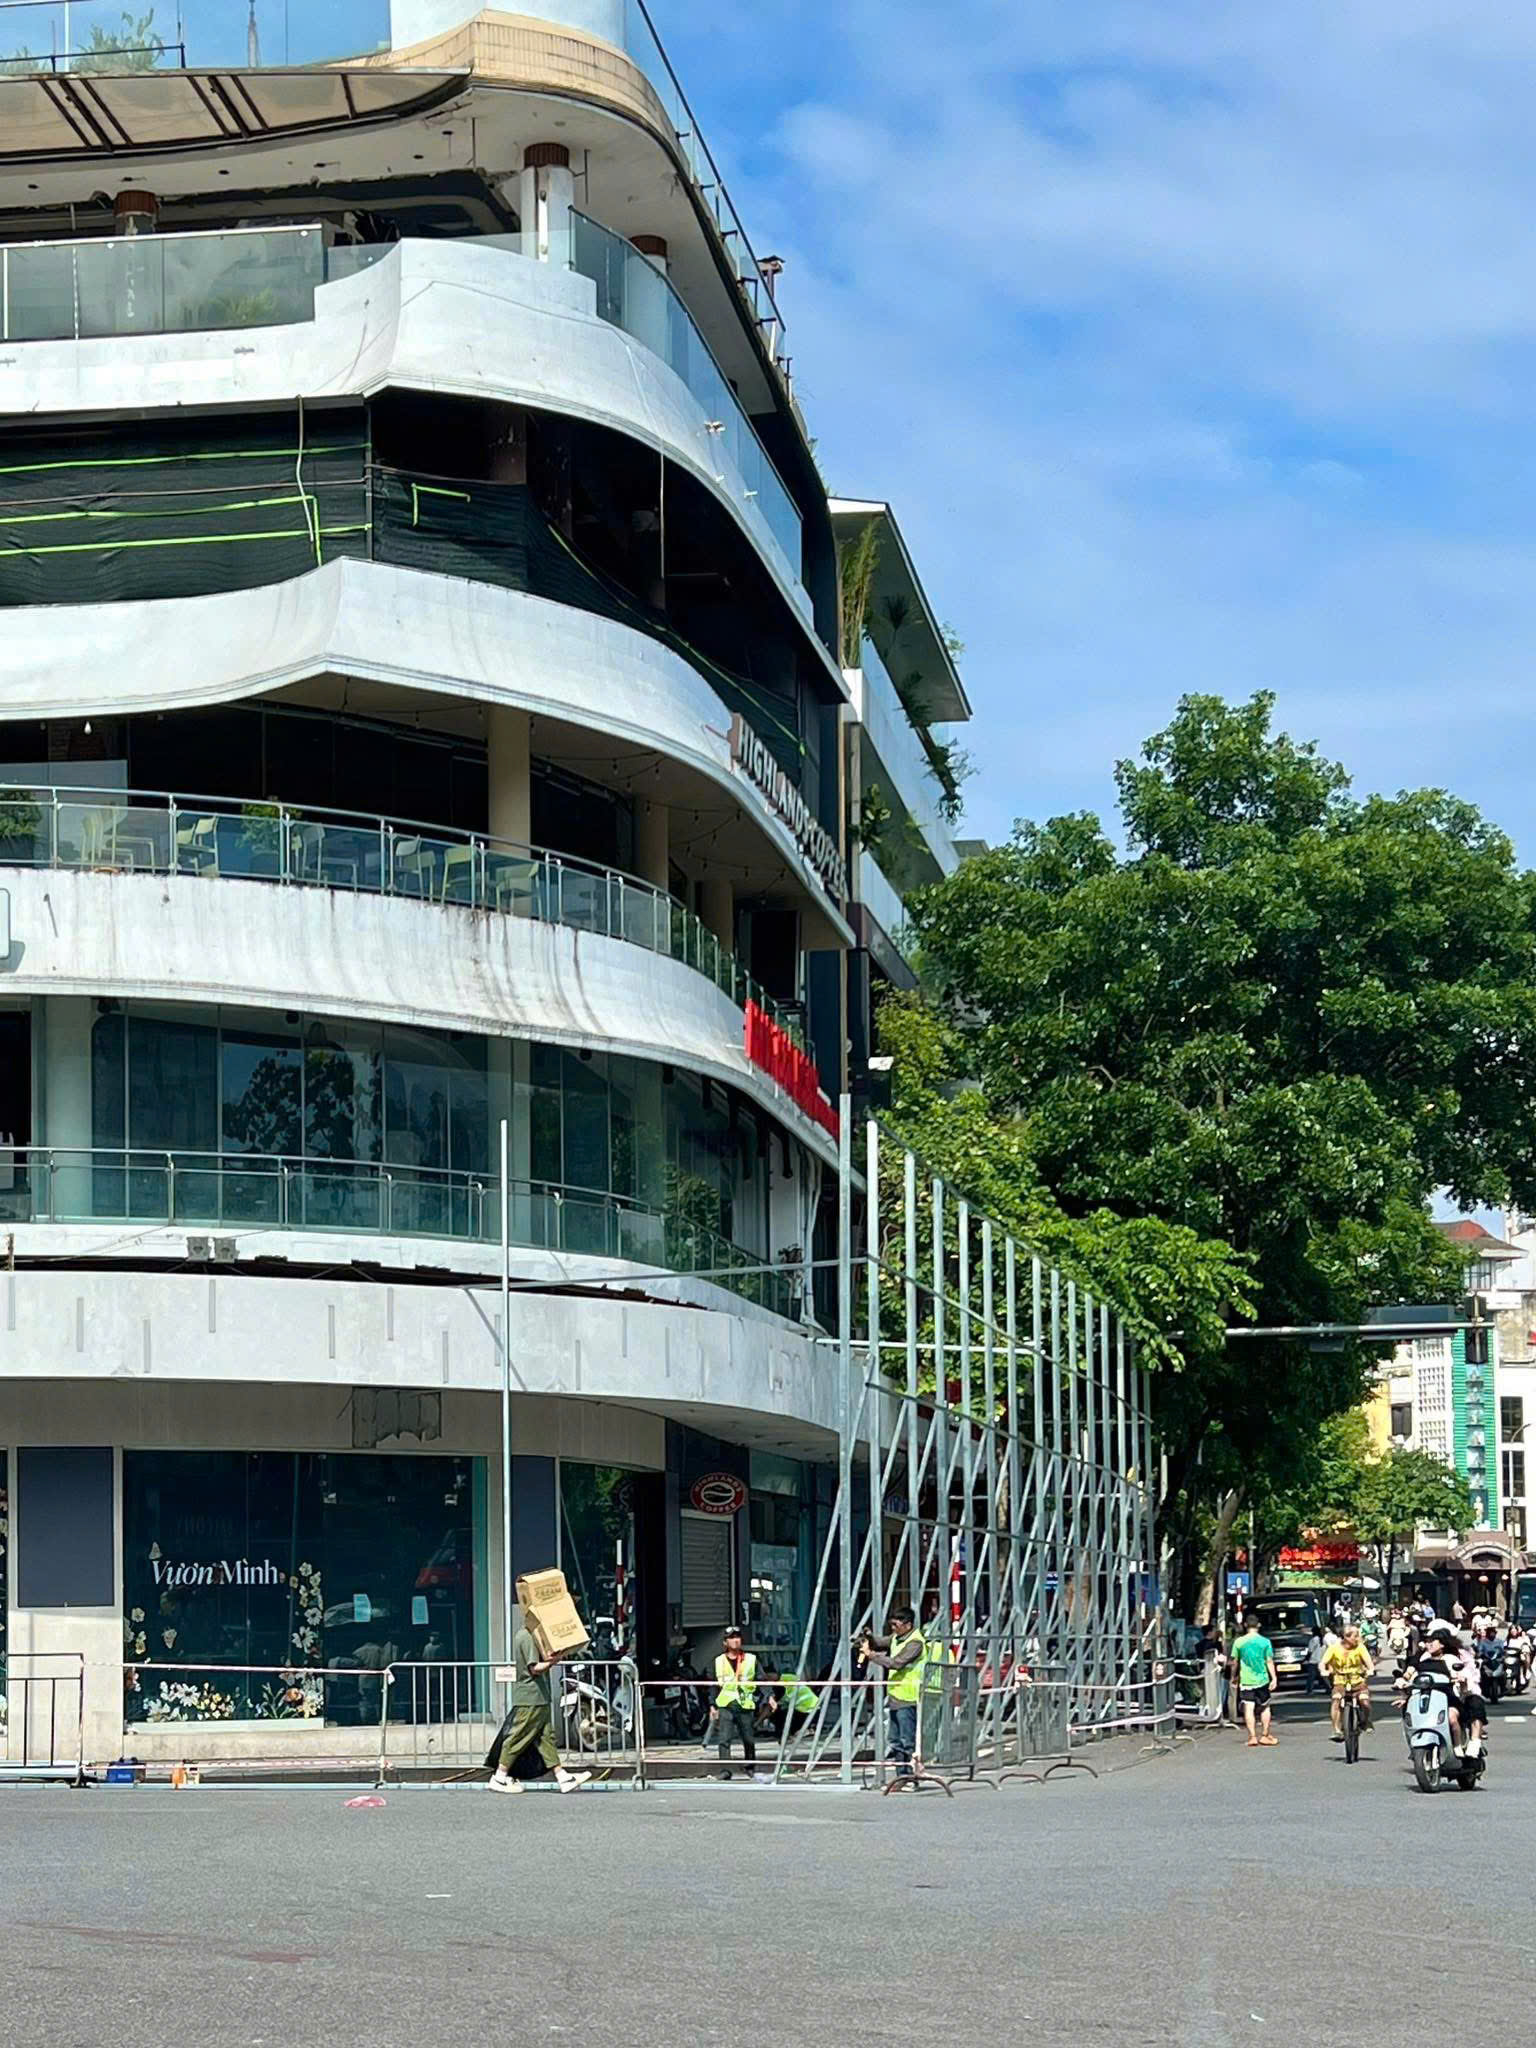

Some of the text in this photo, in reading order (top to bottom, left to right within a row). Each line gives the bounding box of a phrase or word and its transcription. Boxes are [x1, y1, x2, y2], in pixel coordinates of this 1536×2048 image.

[732, 712, 810, 844] HIGHLANDS
[152, 1558, 279, 1585] Vươn Mình
